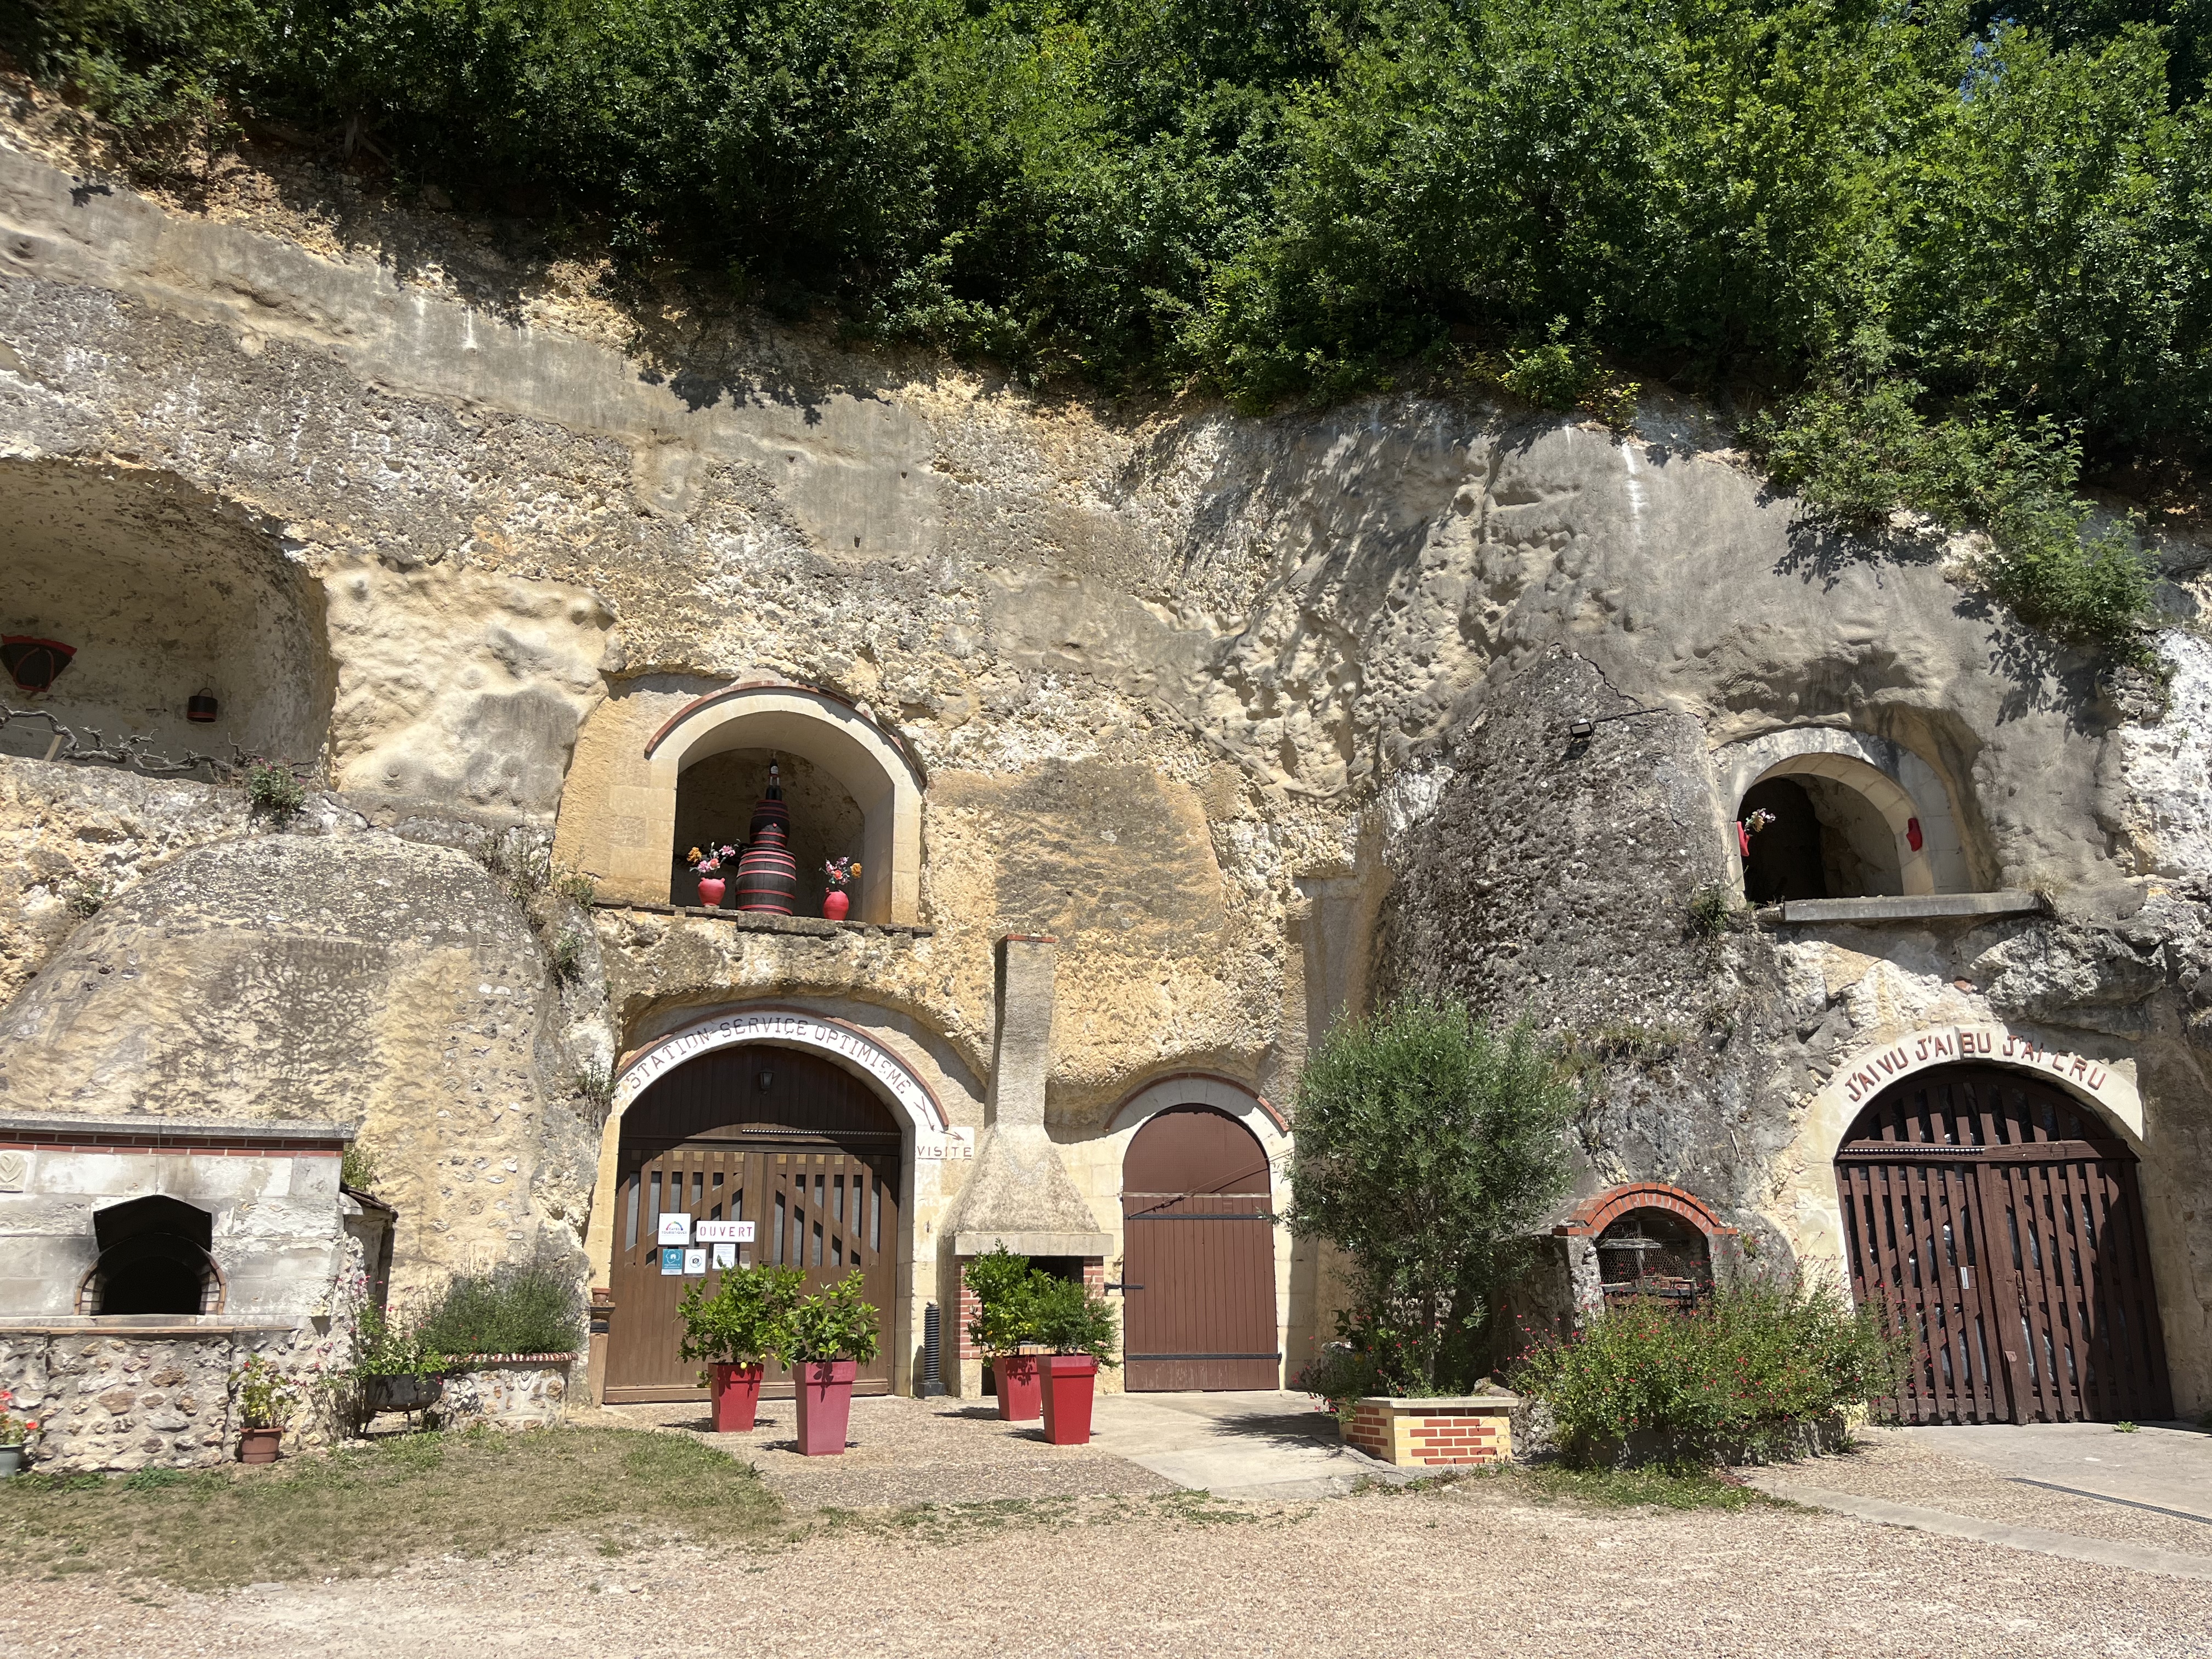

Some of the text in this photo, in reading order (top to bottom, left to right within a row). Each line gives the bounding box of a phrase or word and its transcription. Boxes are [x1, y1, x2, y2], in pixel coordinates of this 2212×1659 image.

[626, 1017, 911, 1094] STATION SERVICE OPTIMISME
[1845, 1032, 2106, 1102] J'AI VU J'AI BU J'AI CRU
[917, 1146, 972, 1158] VISITE
[700, 1226, 753, 1237] OUVERT
